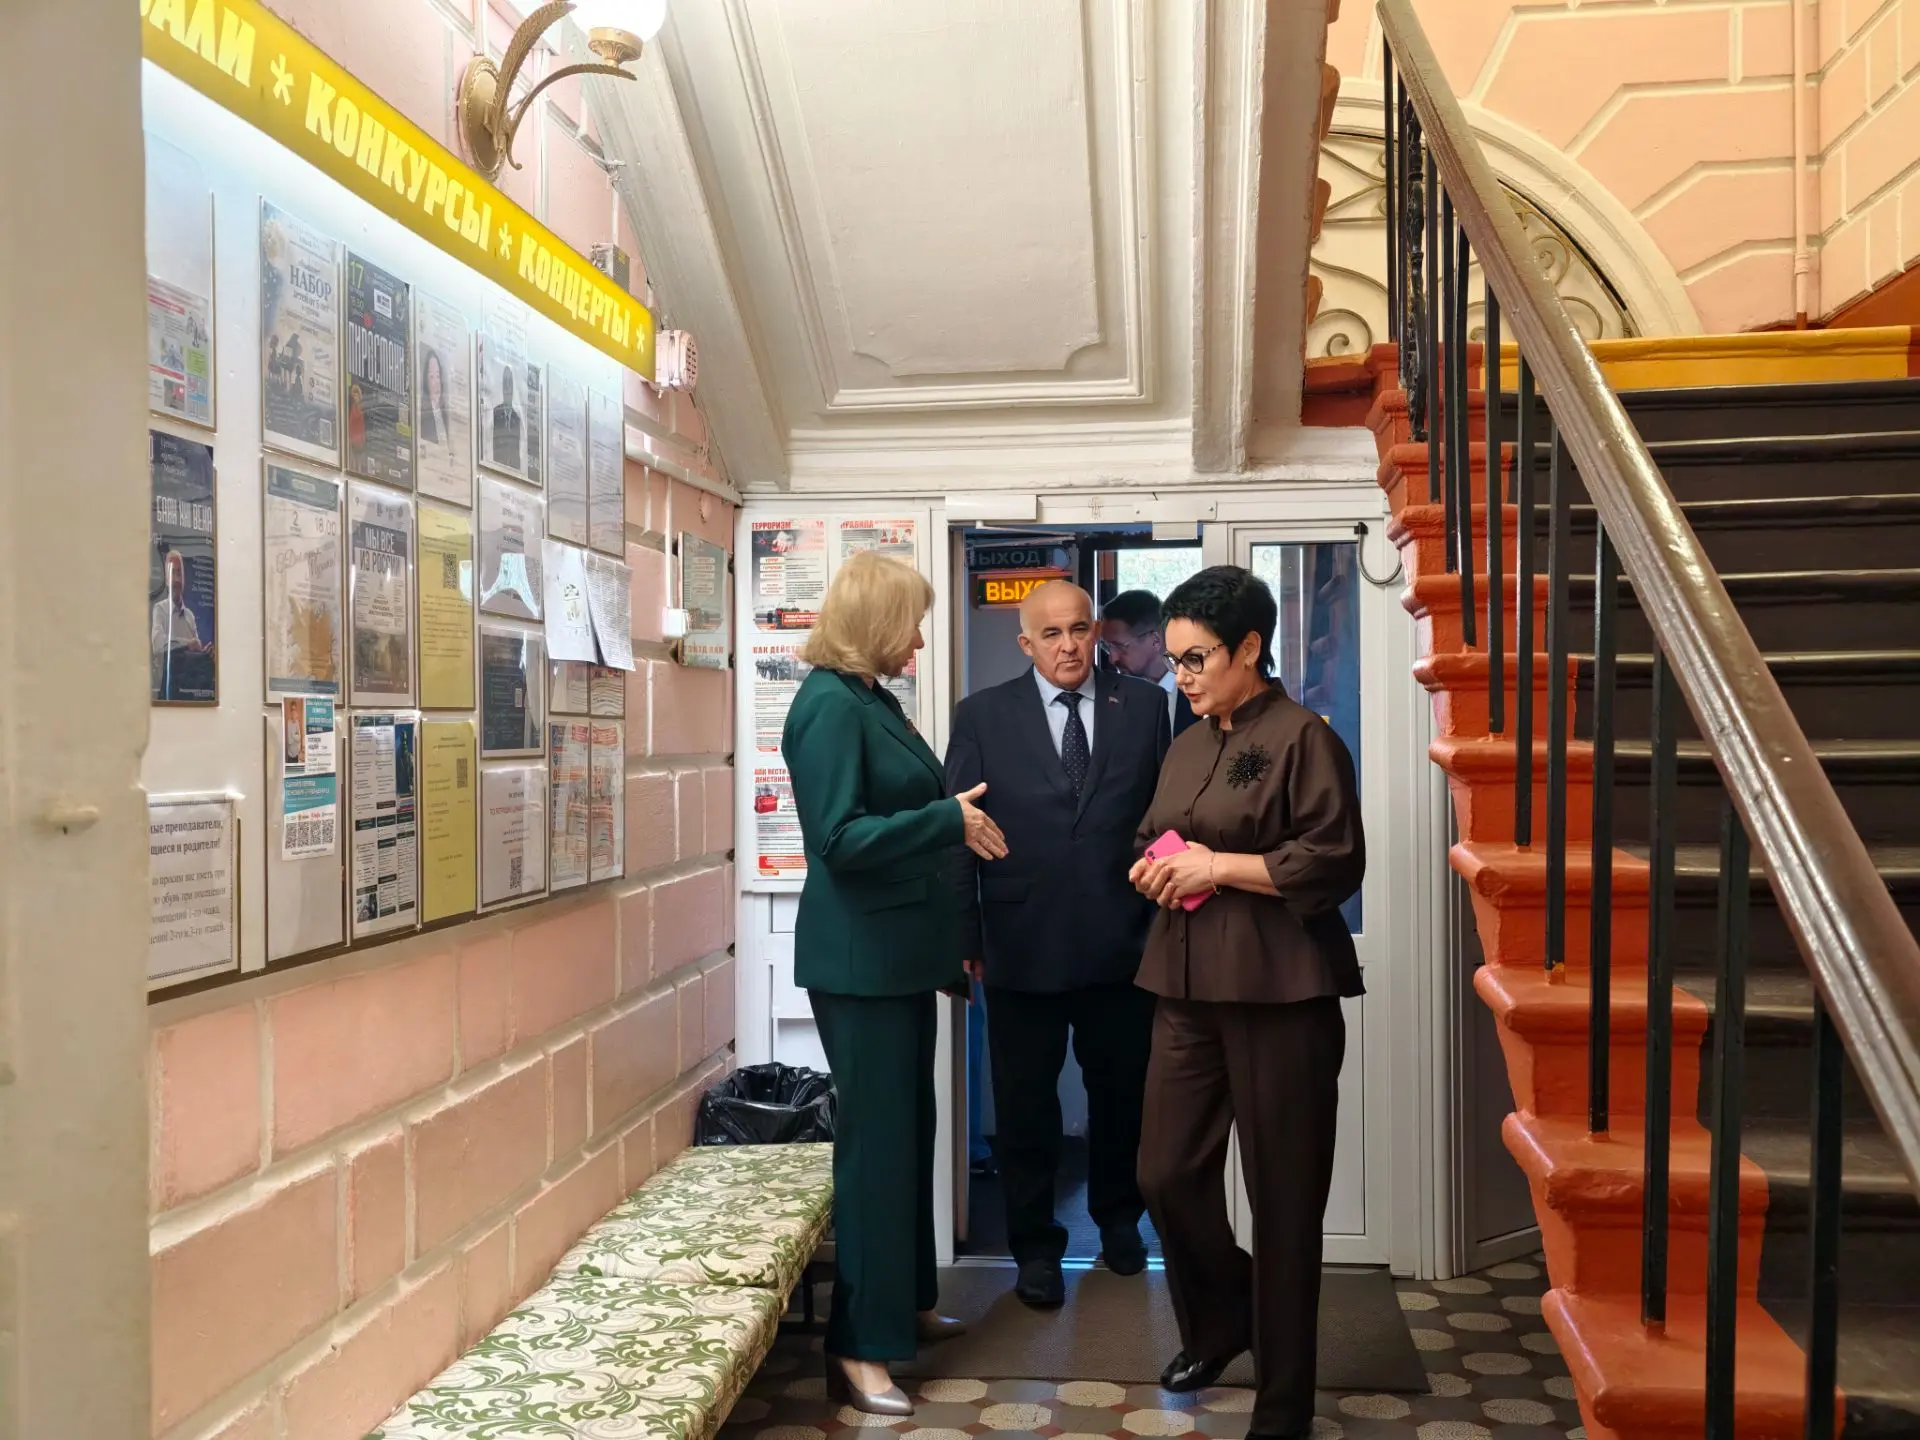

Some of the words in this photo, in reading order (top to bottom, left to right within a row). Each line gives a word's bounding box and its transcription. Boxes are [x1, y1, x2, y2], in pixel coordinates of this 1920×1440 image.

[141, 0, 256, 88] АЛИ
[305, 71, 492, 252] КОНКУРСЫ
[518, 231, 632, 348] КОНЦЕРТЫ
[289, 264, 332, 301] НАБОР
[350, 261, 364, 289] 17
[752, 521, 792, 530] ТЕРРОРИЗМ
[365, 527, 379, 550] МЫ
[381, 531, 396, 553] ВСЕ
[986, 580, 1047, 601] ВЫХ
